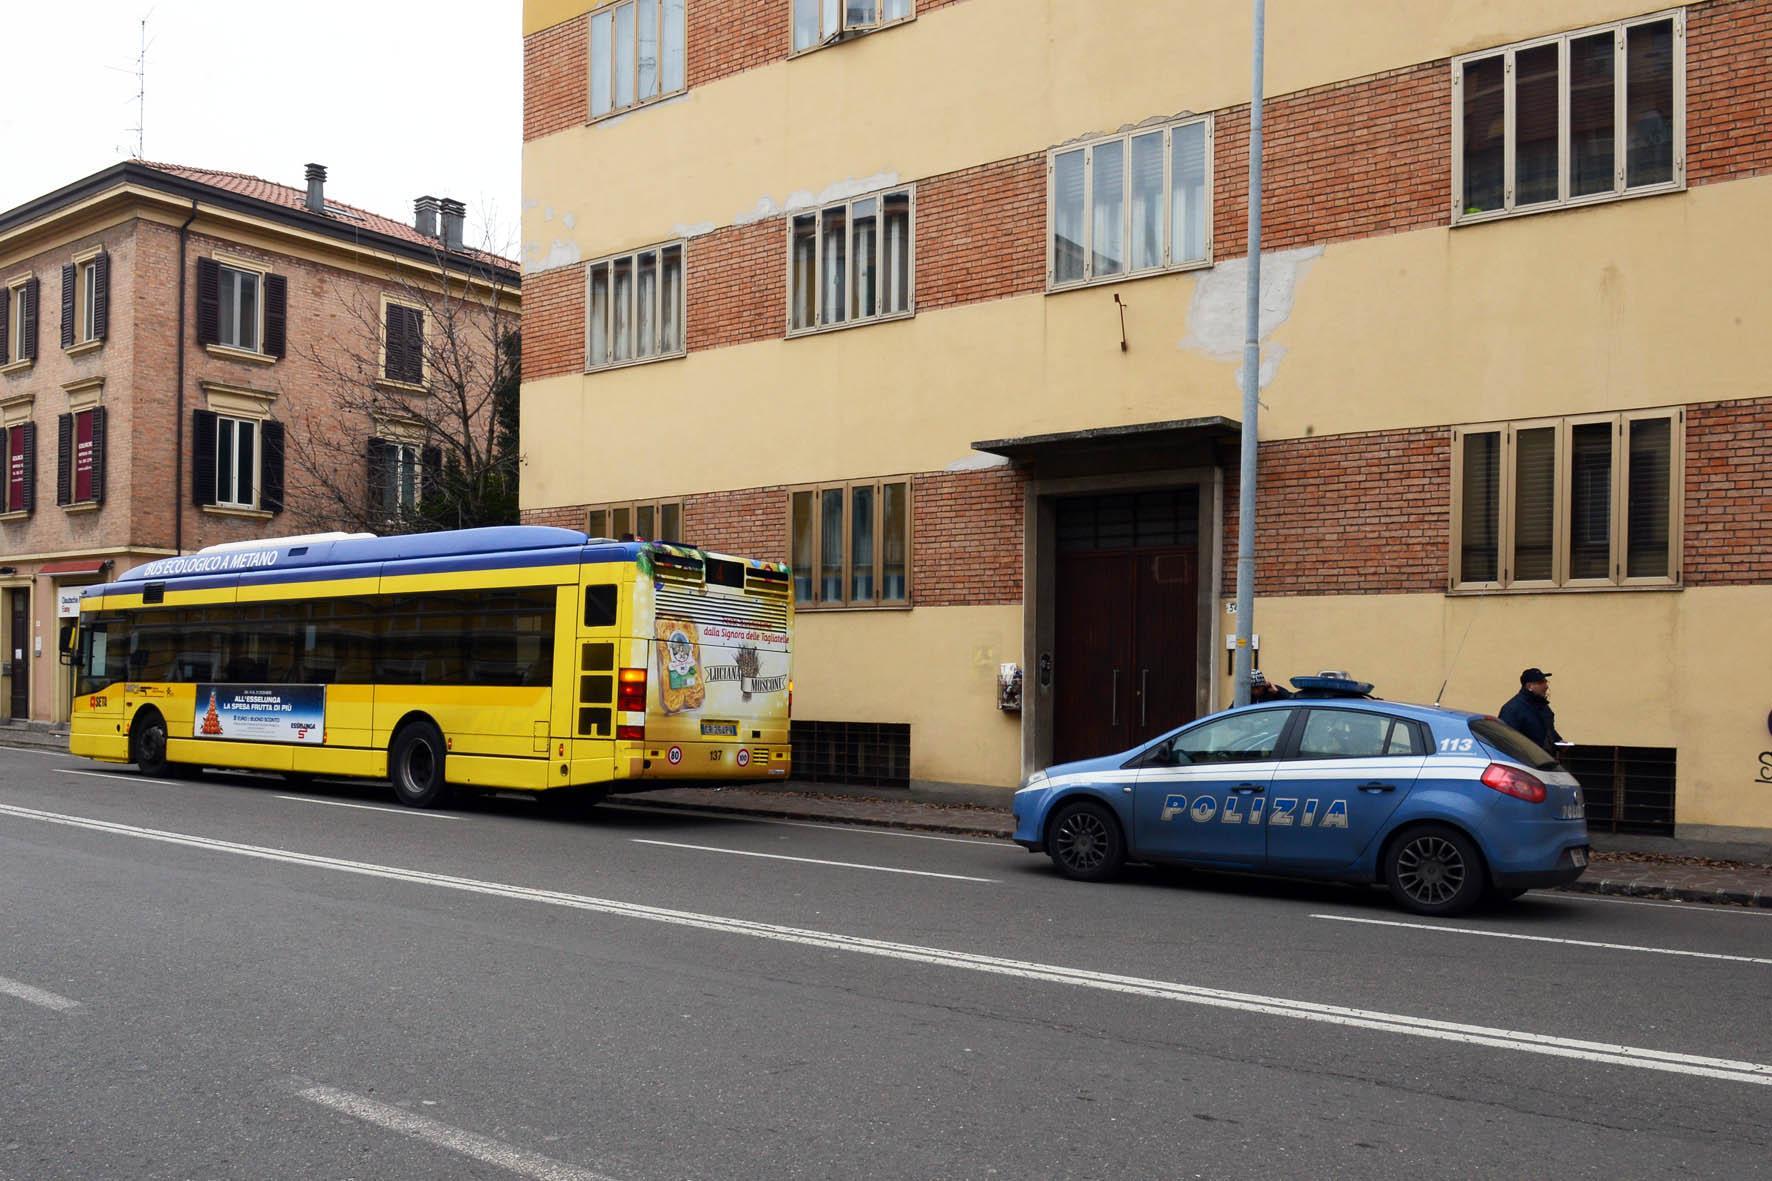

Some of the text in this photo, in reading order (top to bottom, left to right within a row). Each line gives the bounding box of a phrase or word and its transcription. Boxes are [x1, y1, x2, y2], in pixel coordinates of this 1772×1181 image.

[144, 550, 278, 576] BUS ECOLOGICO A METANO
[703, 627, 720, 636] dalla
[721, 628, 745, 640] Signora
[745, 631, 760, 640] delle
[231, 703, 251, 711] SPESA
[1440, 738, 1473, 752] 113
[670, 750, 679, 760] 80
[709, 750, 723, 761] 137
[739, 753, 747, 762] 100
[1161, 794, 1349, 829] POLIZIA
